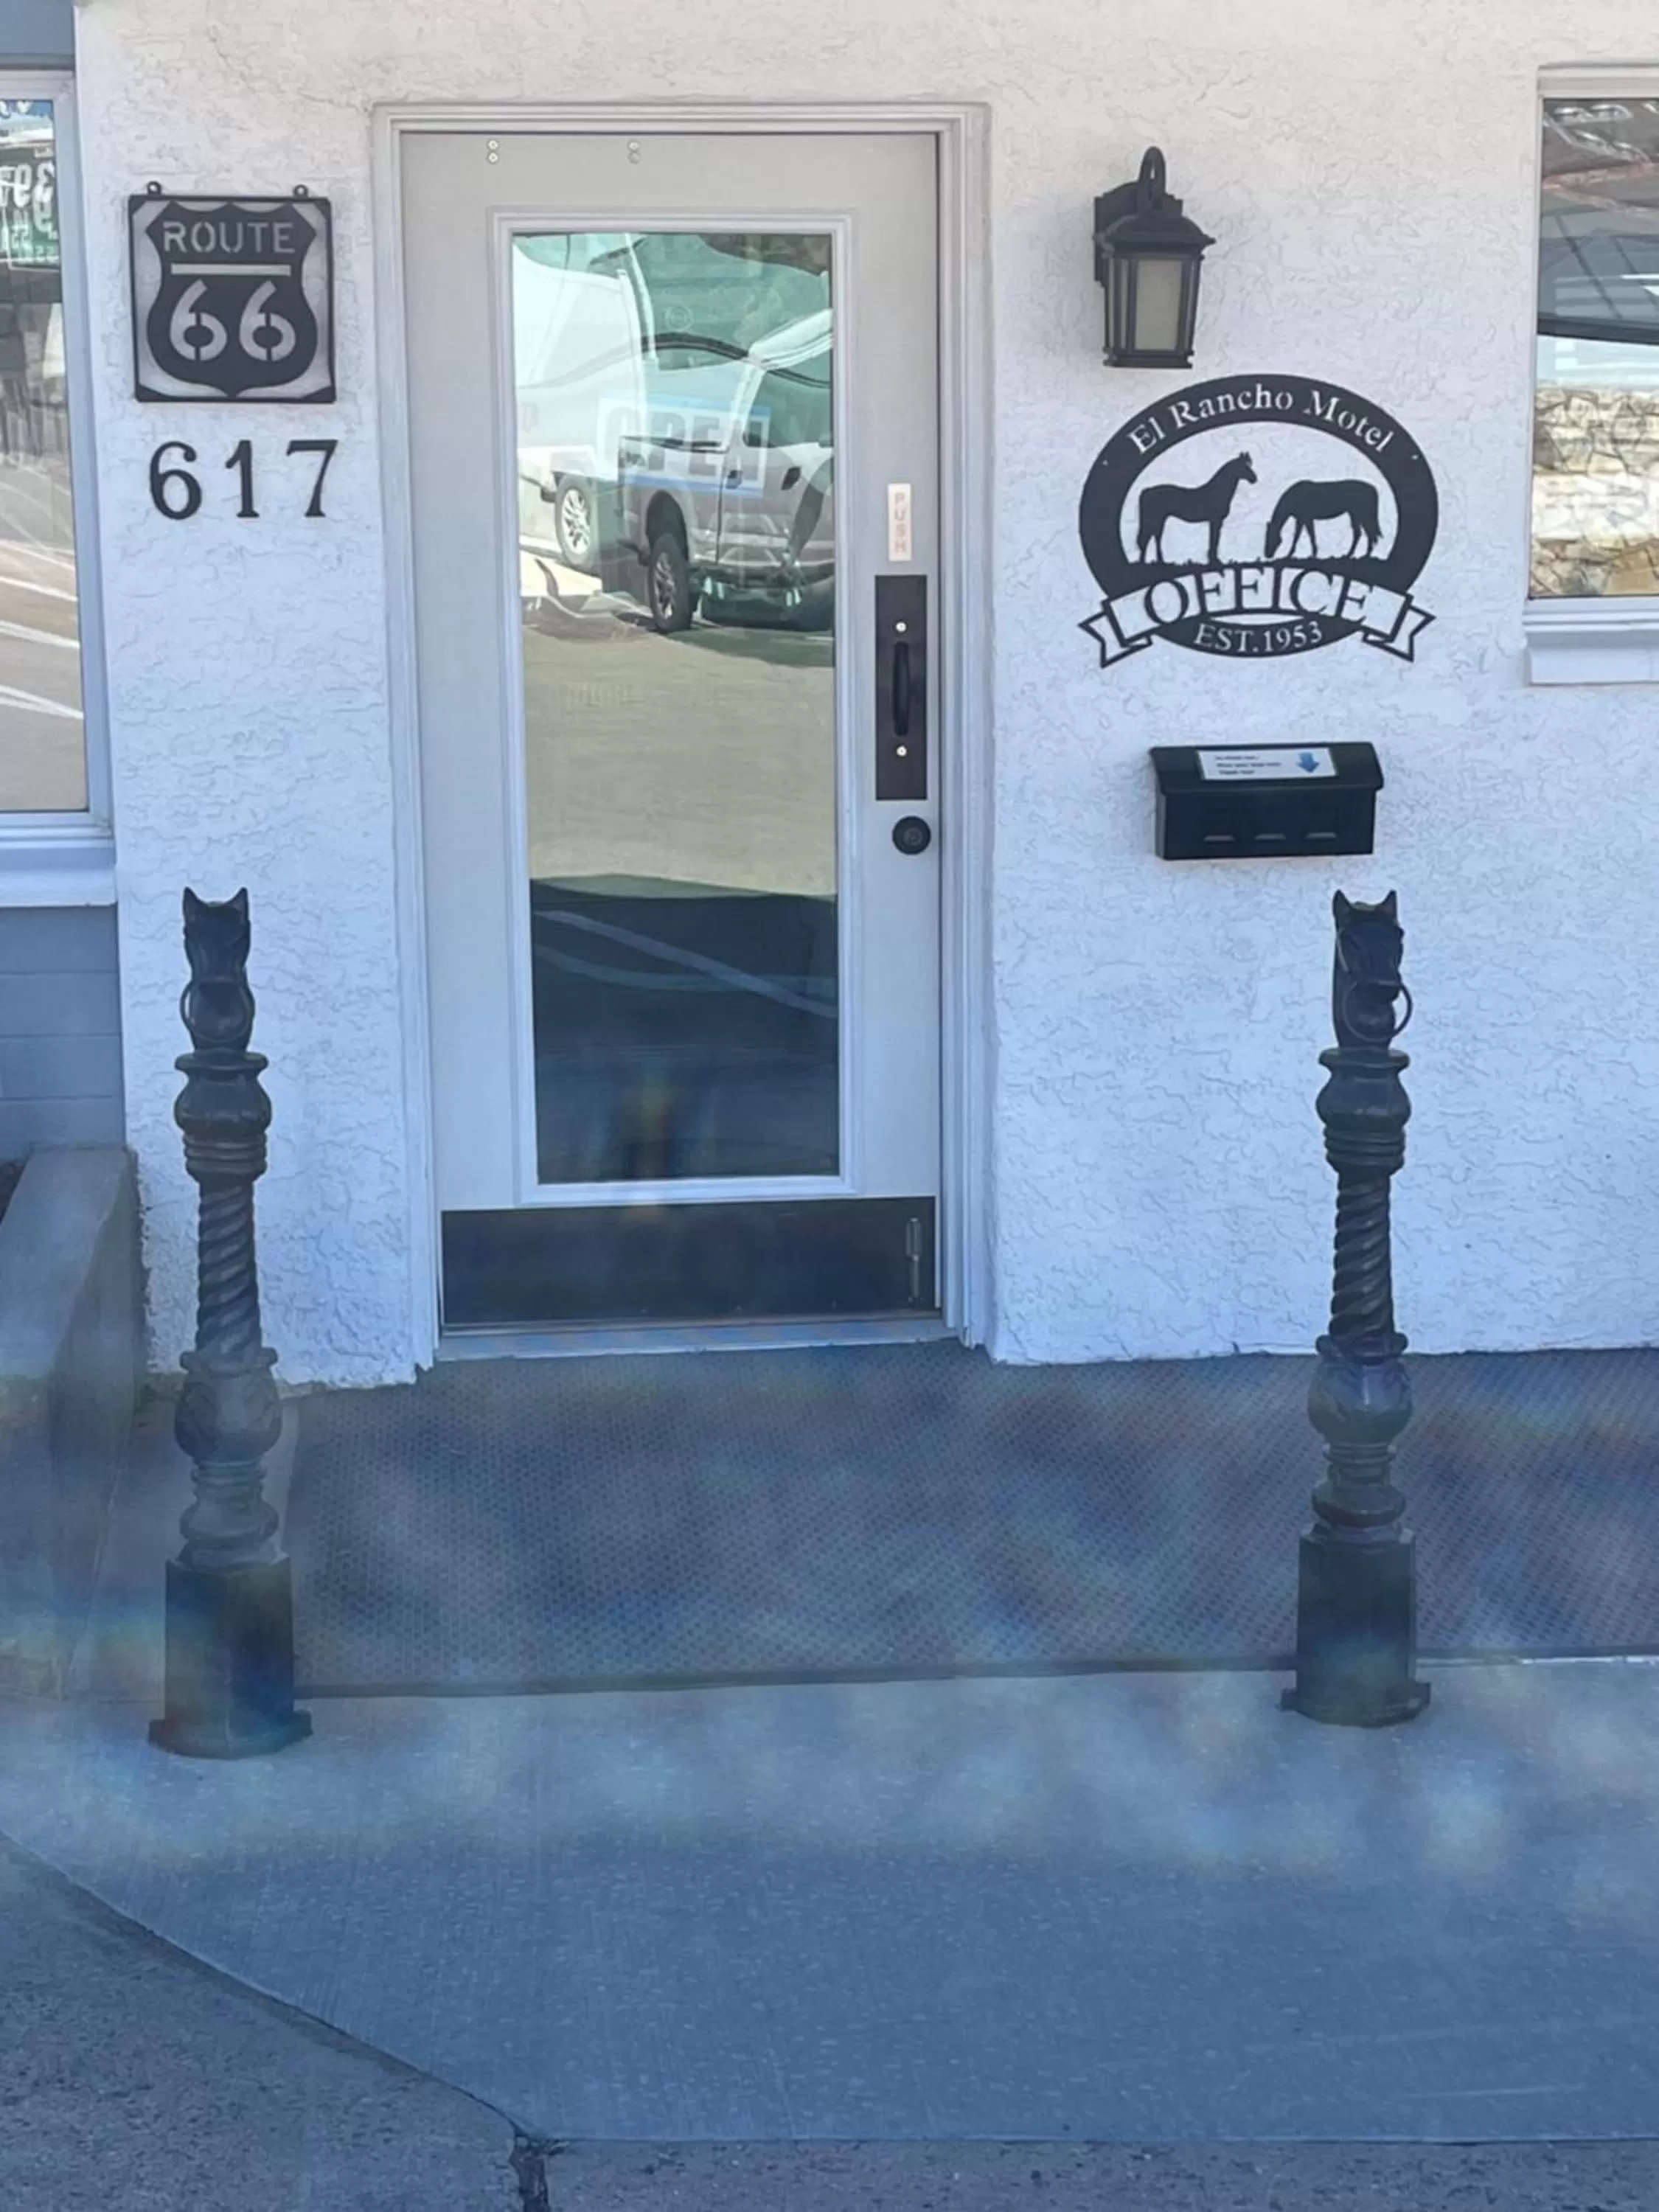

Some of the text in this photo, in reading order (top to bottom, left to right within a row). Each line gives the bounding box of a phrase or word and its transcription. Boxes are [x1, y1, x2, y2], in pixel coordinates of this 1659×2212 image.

[163, 221, 295, 253] ROUTE
[169, 279, 296, 361] 66
[1128, 383, 1394, 454] El Rancho Motel
[150, 439, 338, 520] 617
[1145, 566, 1371, 625] OFFICE
